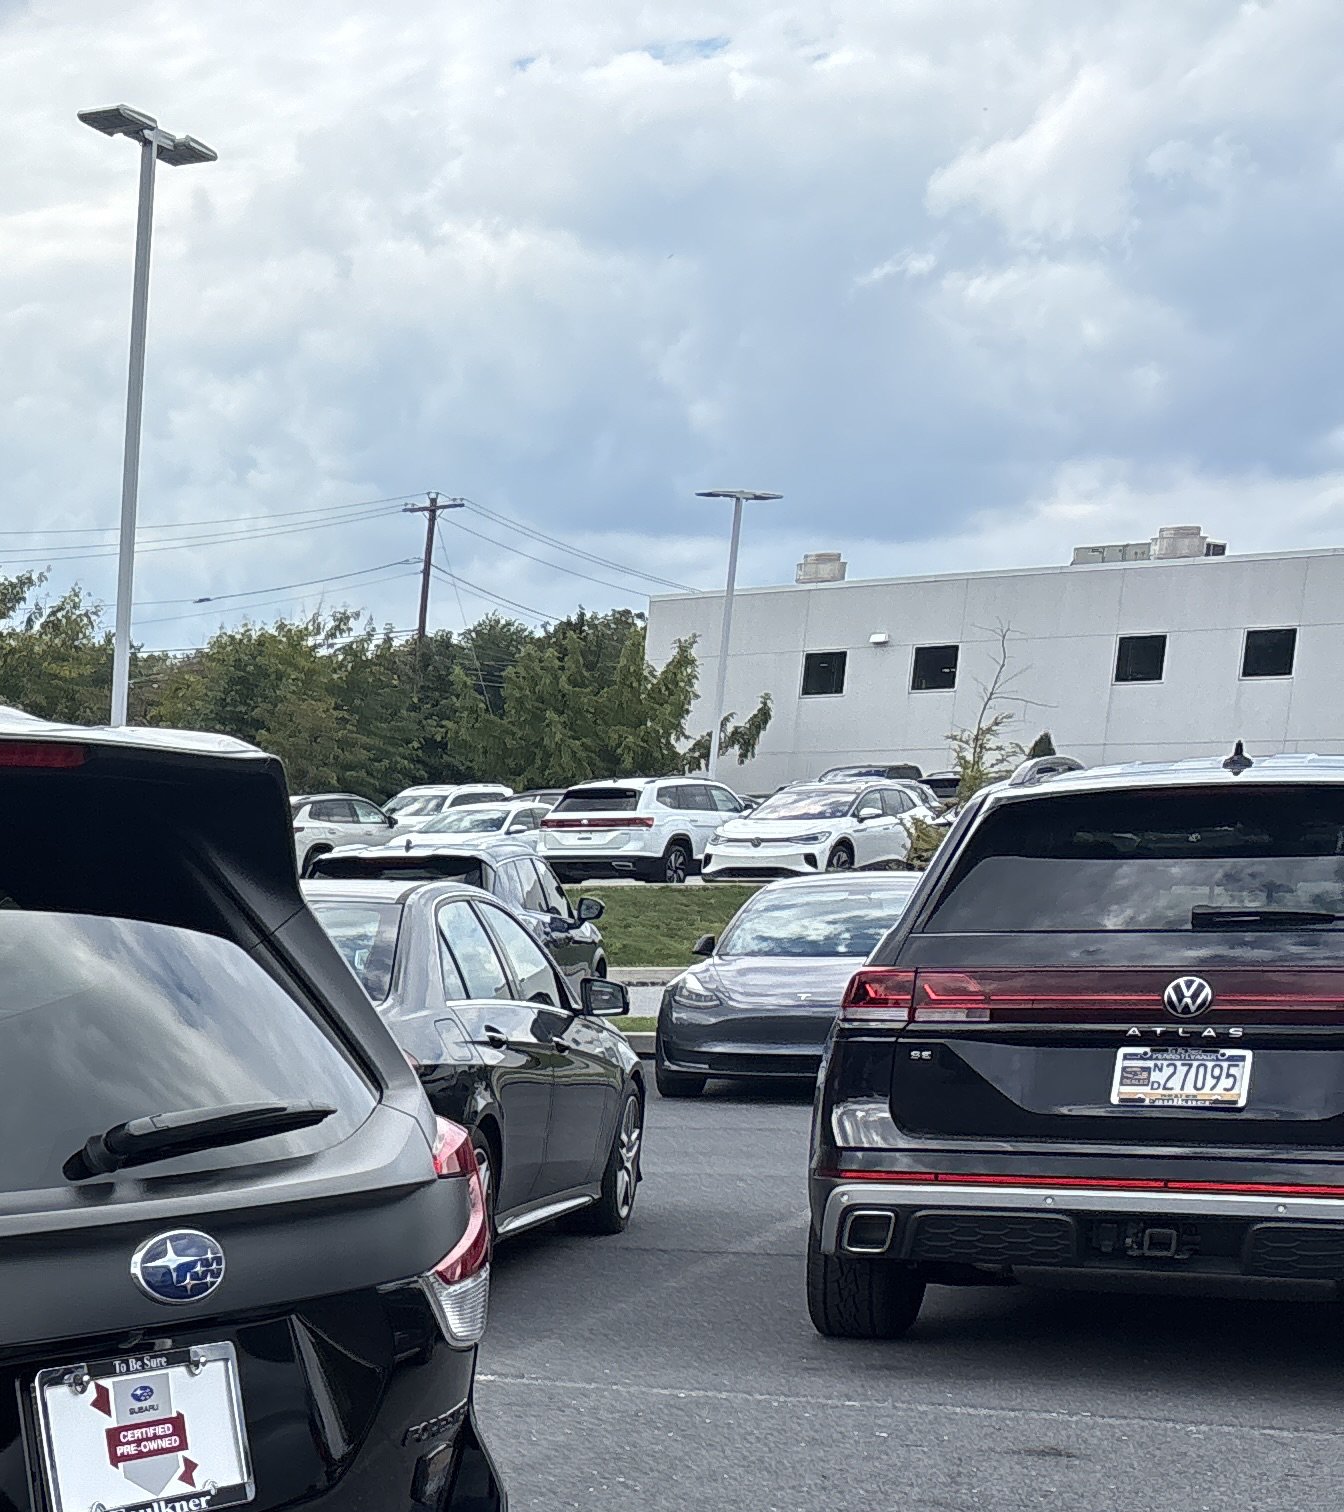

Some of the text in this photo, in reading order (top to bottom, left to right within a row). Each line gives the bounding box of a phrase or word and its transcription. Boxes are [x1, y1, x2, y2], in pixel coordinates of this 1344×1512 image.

[1126, 1026, 1244, 1038] ATLAS
[1162, 1062, 1240, 1092] 27095
[113, 1355, 168, 1374] To Be Sure
[128, 1404, 159, 1415] SUBARU
[119, 1423, 173, 1443] CERTIFIED
[116, 1436, 180, 1457] PRE-OWNED
